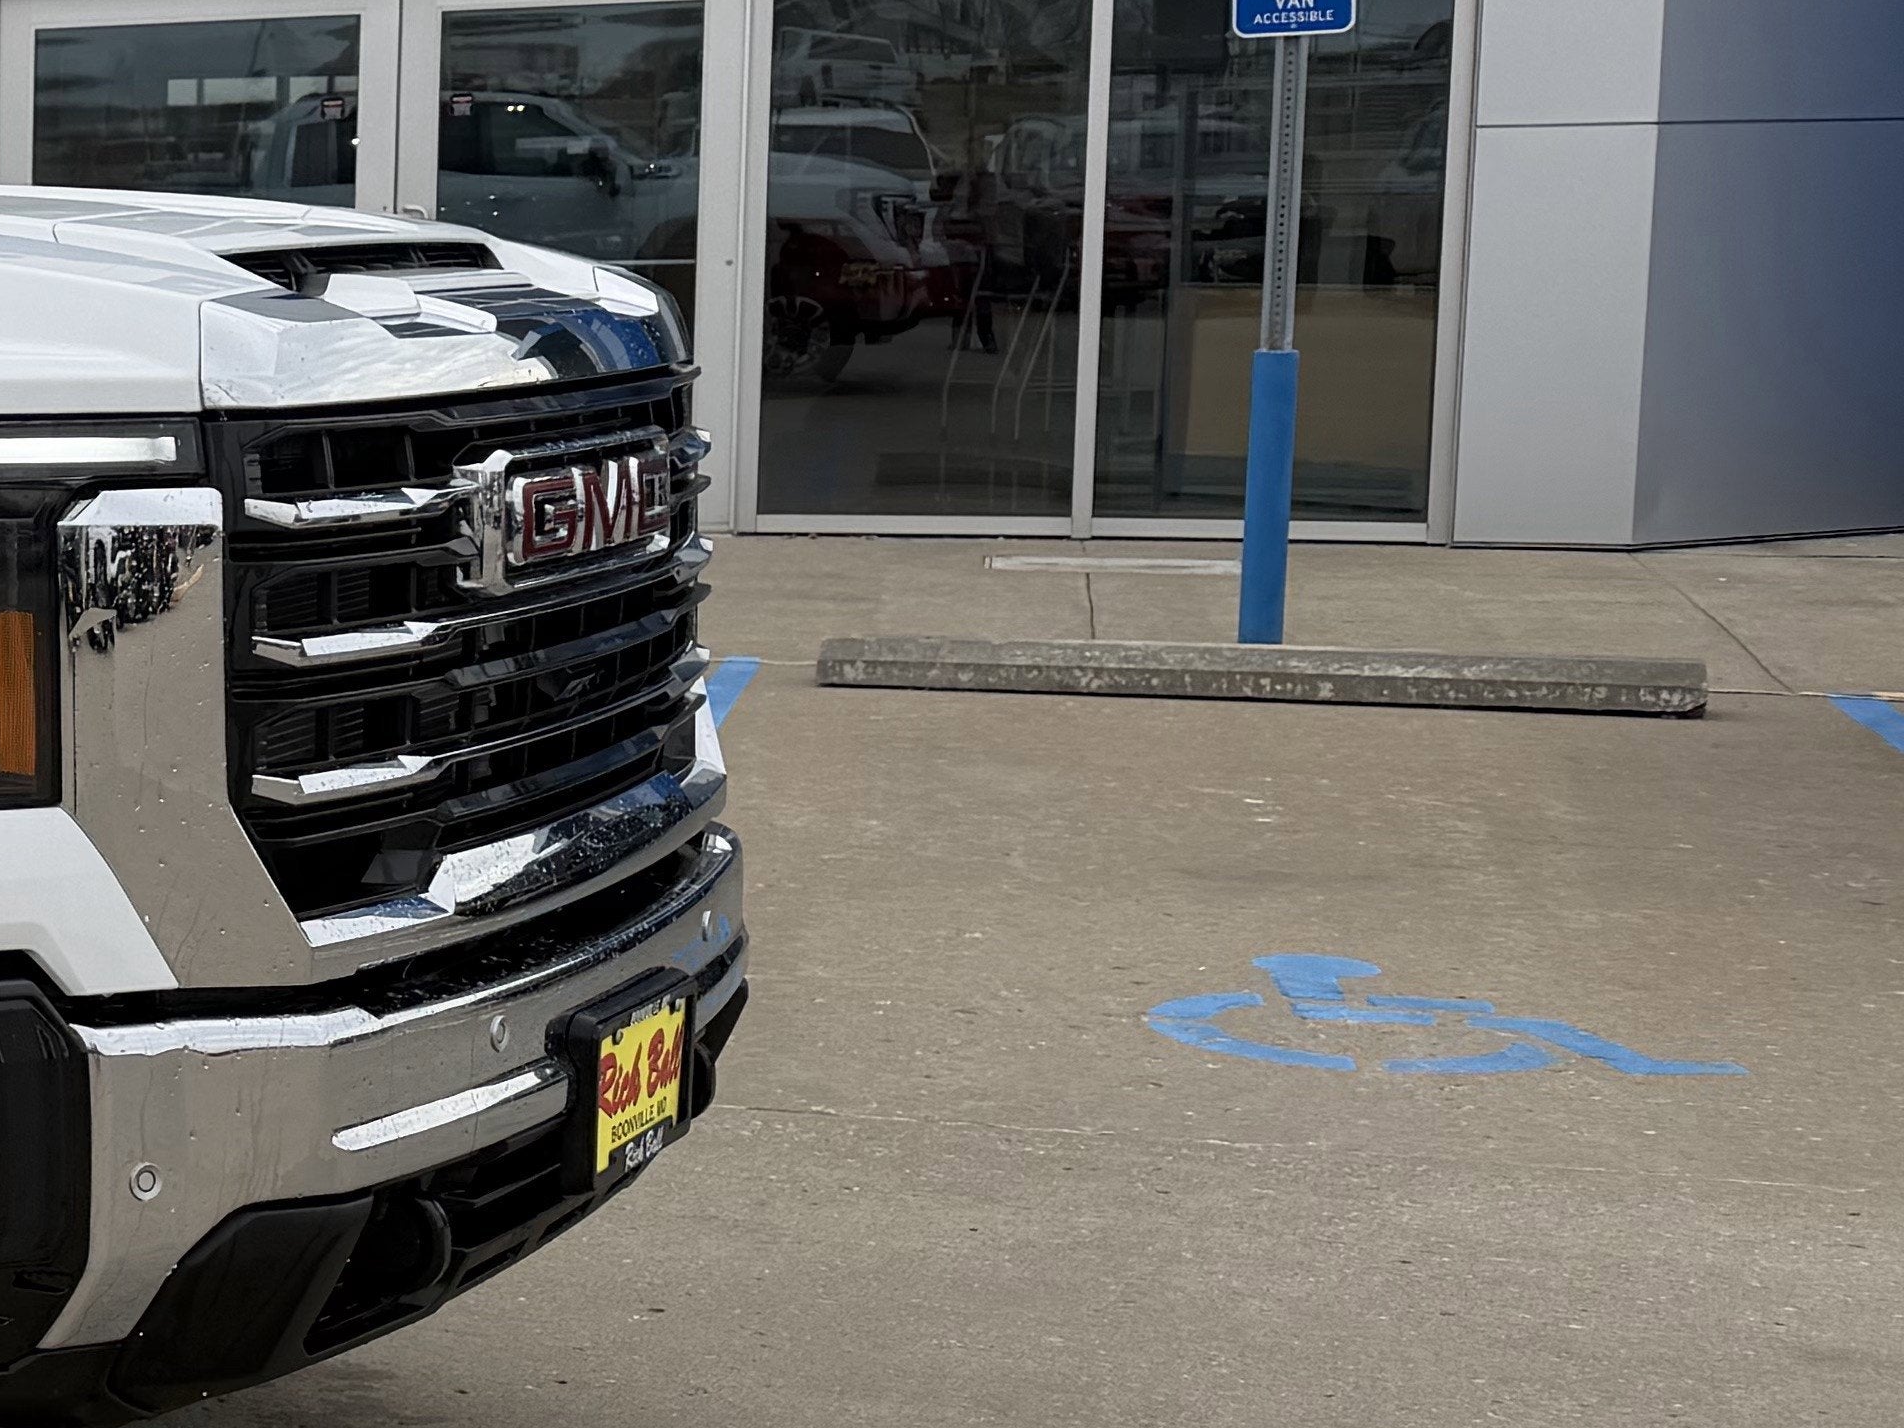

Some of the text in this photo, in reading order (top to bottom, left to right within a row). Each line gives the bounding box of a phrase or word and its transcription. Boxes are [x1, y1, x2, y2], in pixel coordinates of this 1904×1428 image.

[1253, 9, 1334, 25] ACCESSIBLE
[598, 1019, 685, 1119] Rick Ball
